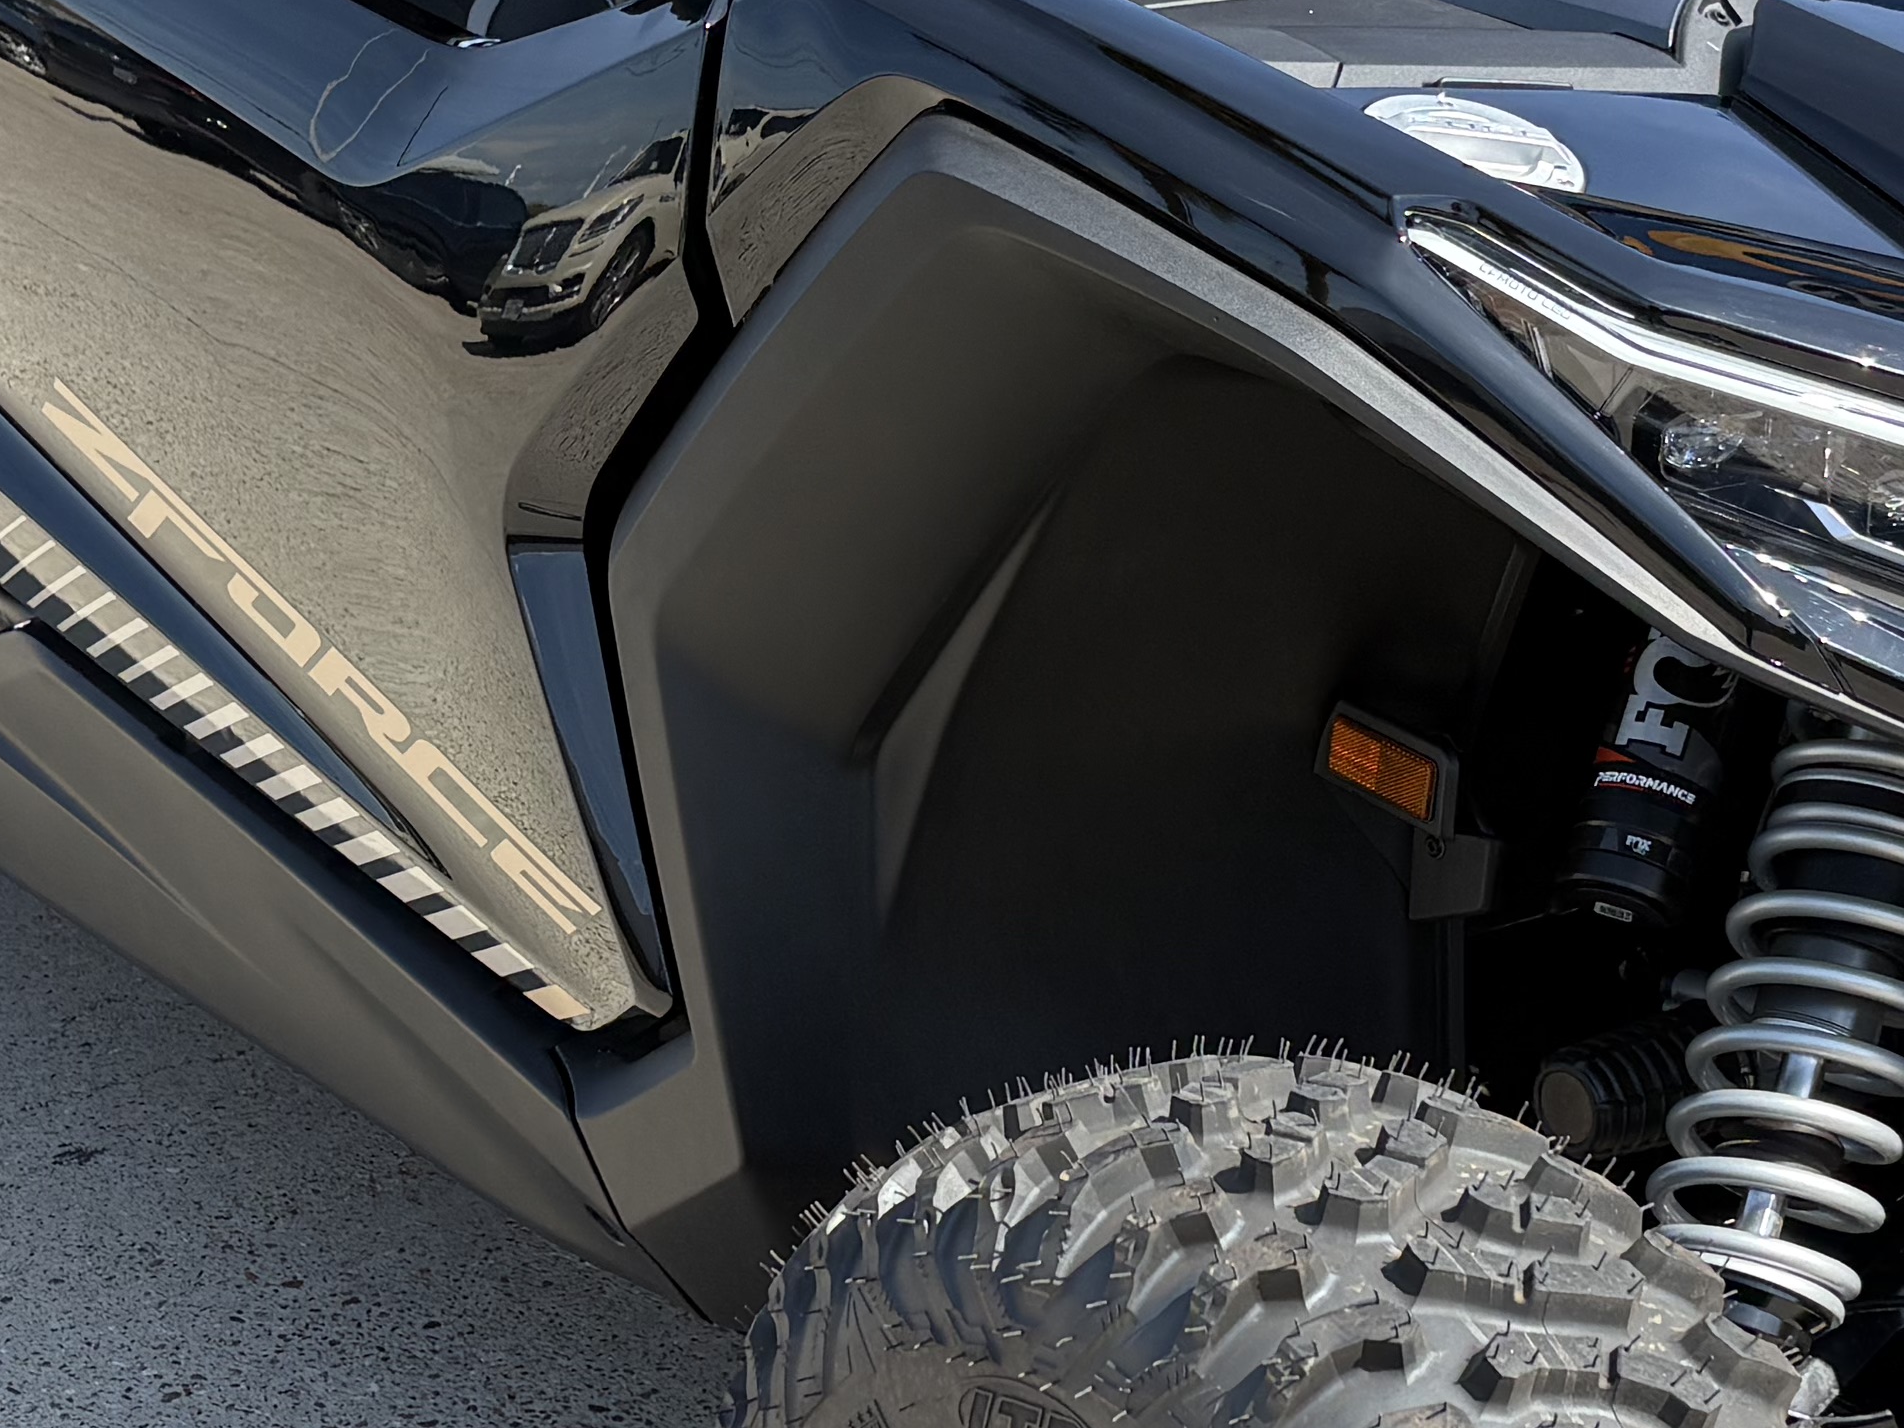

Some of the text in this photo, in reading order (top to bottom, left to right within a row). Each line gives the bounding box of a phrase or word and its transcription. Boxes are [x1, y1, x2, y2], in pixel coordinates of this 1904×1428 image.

[1479, 261, 1539, 301] CFMOTO
[41, 377, 602, 935] ZFORCE
[1615, 626, 1742, 758] FO
[1594, 771, 1697, 805] PERFORMANCE
